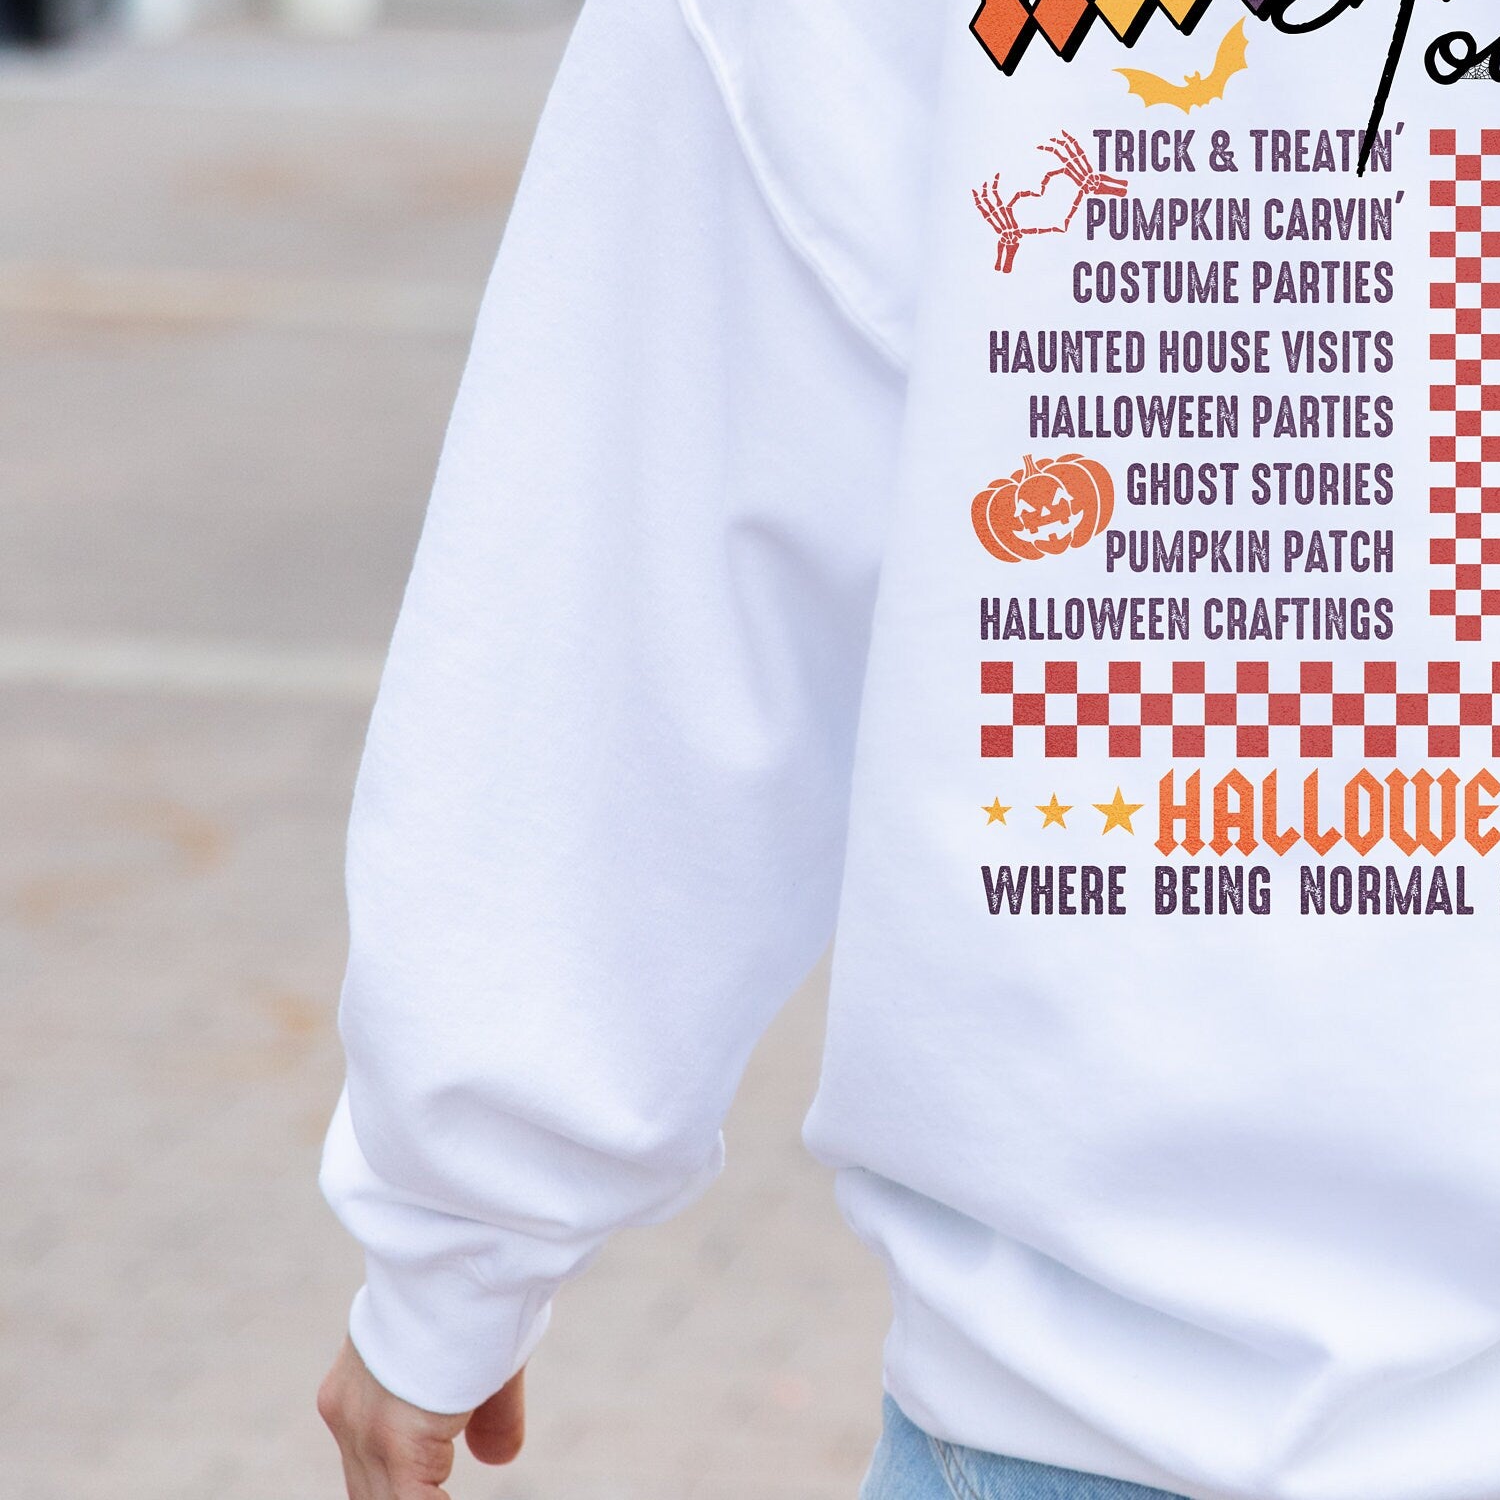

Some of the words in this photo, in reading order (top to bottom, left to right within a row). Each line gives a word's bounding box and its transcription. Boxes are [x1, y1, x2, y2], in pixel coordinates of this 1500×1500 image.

[1093, 129, 1195, 172] TRICK
[1209, 129, 1238, 172] &
[1087, 198, 1250, 241] PUMPKIN
[1264, 191, 1405, 241] CARVIN'
[1073, 261, 1239, 303] COSTUME
[1253, 261, 1393, 303] PARTIES
[990, 331, 1145, 373] HAUNTED
[1159, 331, 1270, 373] HOUSE
[1282, 331, 1393, 373] VISITS
[1030, 395, 1238, 438] HALLOWEEN
[1253, 395, 1393, 438] PARTIES
[1127, 463, 1239, 505] GHOST
[1252, 463, 1393, 505] STORIES
[1106, 530, 1270, 573] PUMPKIN
[1284, 530, 1393, 573] PATCH
[981, 597, 1189, 640] HALLOWEEN
[1204, 597, 1393, 640] CRAFTINGS
[981, 865, 1127, 915] WHERE
[1155, 865, 1270, 915] BEING
[1300, 865, 1474, 915] NORMAL
